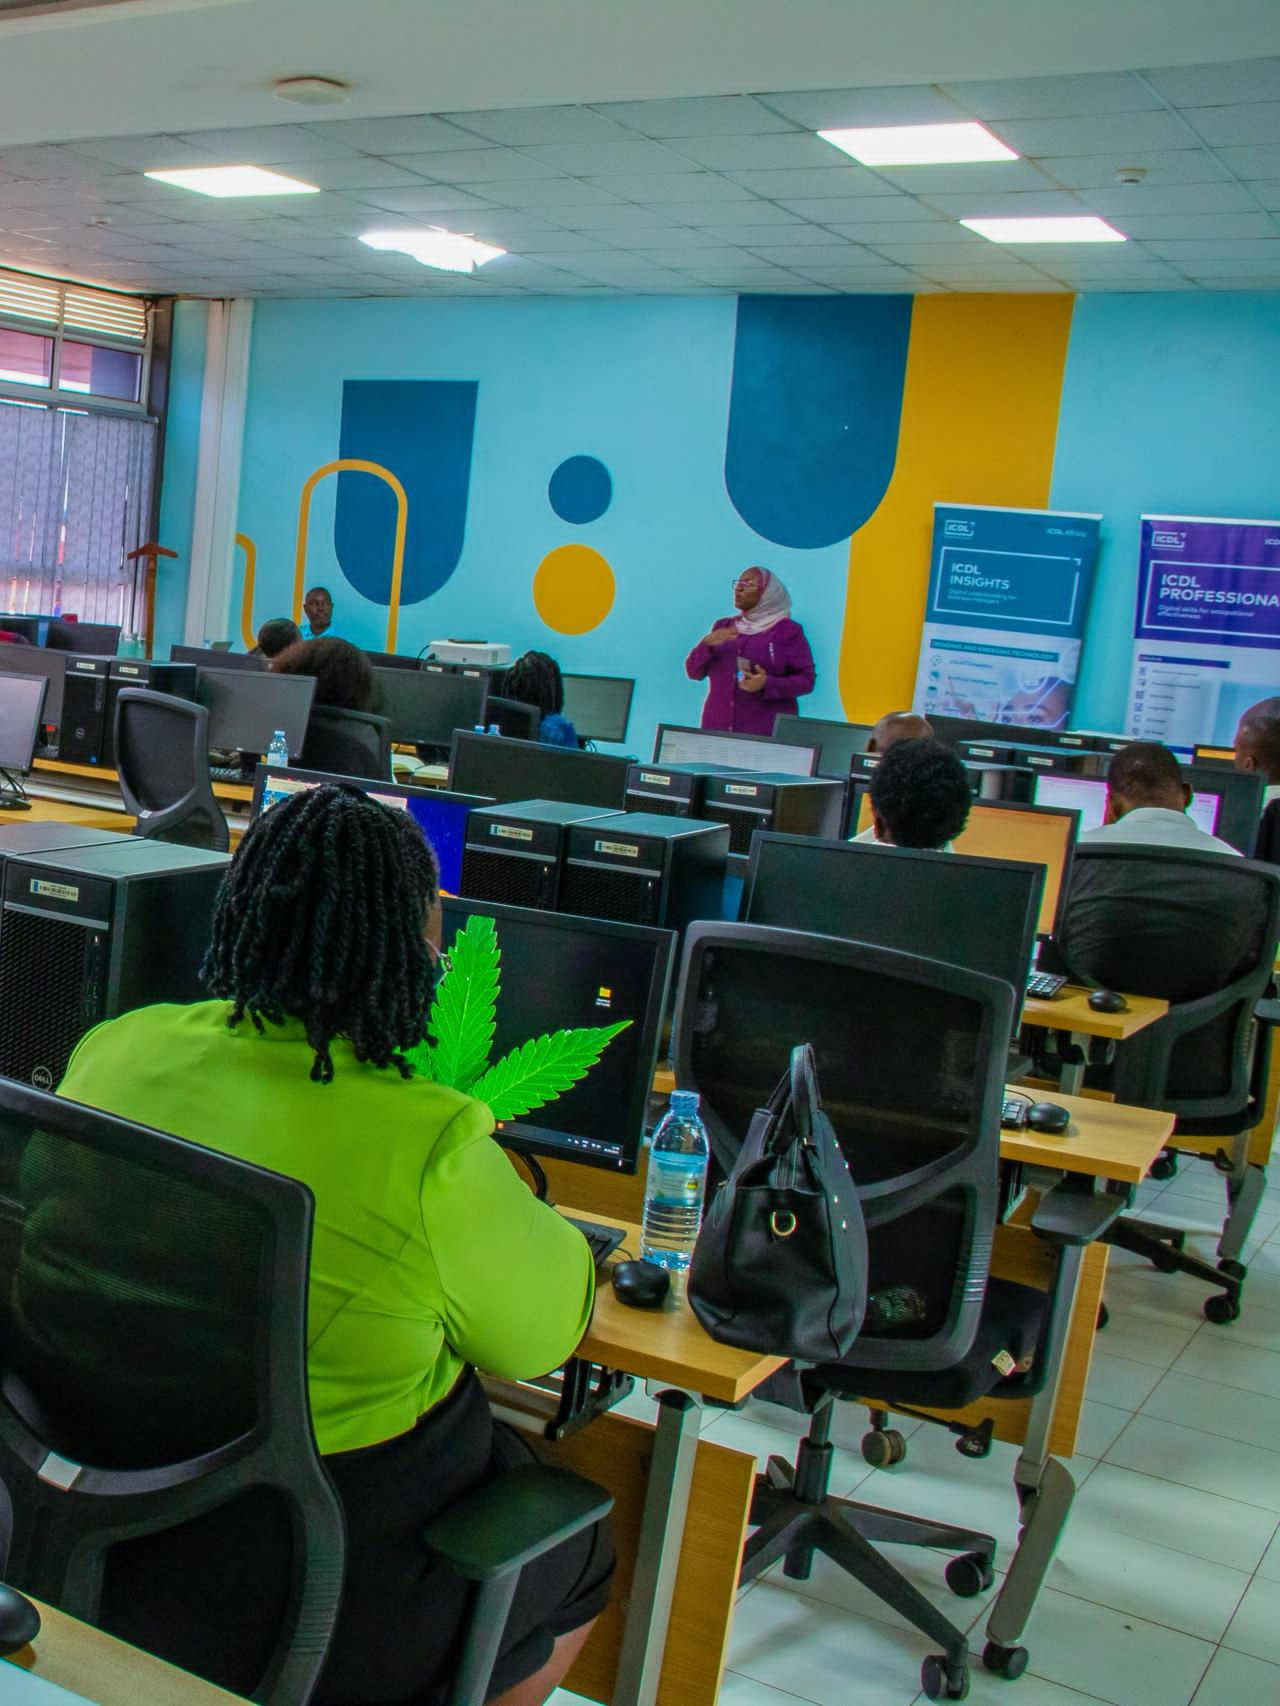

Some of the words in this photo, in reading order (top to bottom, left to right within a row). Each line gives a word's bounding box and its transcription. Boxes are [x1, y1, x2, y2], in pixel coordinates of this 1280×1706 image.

[948, 523, 969, 533] ICDL
[1156, 535, 1180, 544] ICDL
[951, 563, 981, 574] ICDL
[950, 575, 1010, 589] INSIGHTS
[1161, 574, 1200, 587] ICDL
